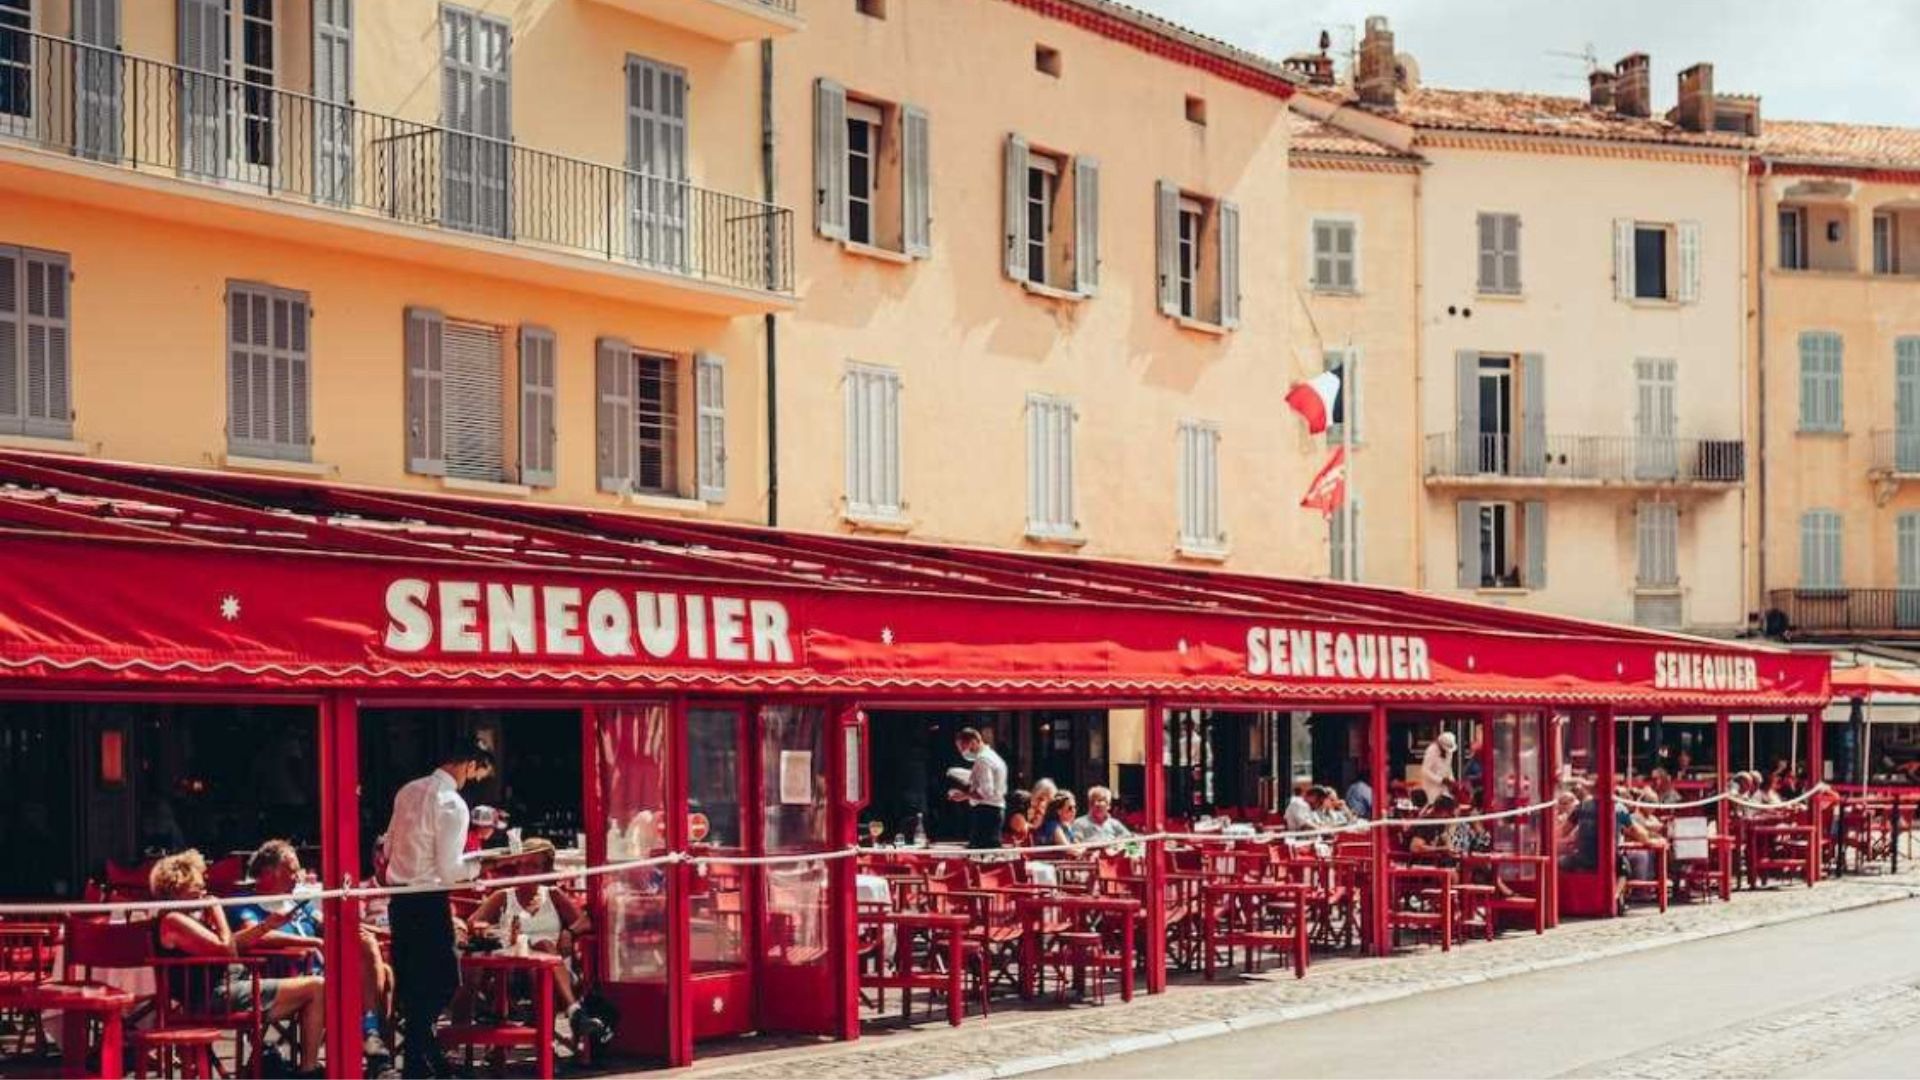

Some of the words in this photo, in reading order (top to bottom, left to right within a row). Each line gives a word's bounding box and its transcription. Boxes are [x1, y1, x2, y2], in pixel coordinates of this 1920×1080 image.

[384, 578, 794, 663] SENEQUIER
[1247, 626, 1431, 681] SENEQUIER
[1654, 651, 1759, 691] SENEQUIER
